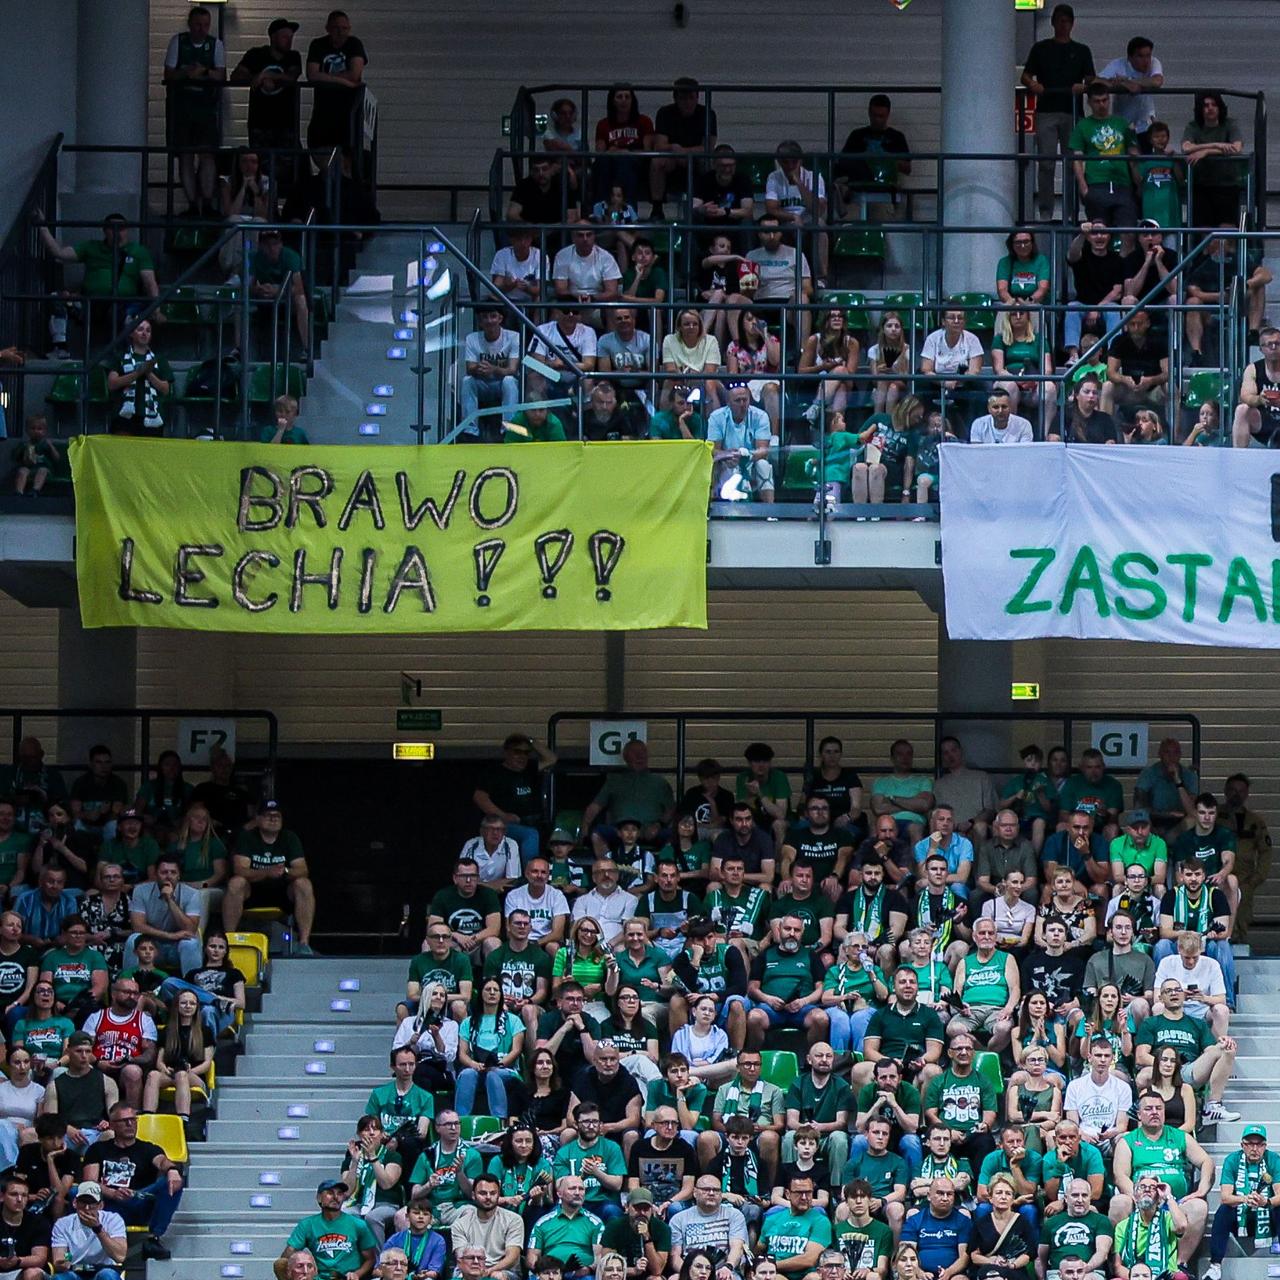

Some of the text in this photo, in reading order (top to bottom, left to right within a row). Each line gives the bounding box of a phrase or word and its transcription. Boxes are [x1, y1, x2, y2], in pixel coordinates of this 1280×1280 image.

[235, 466, 519, 533] BRAWO
[119, 537, 436, 613] LECHIA
[190, 730, 228, 754] F2
[1099, 733, 1138, 758] G1
[1156, 1030, 1195, 1044] ZASTAL
[1081, 1102, 1113, 1118] Zastal
